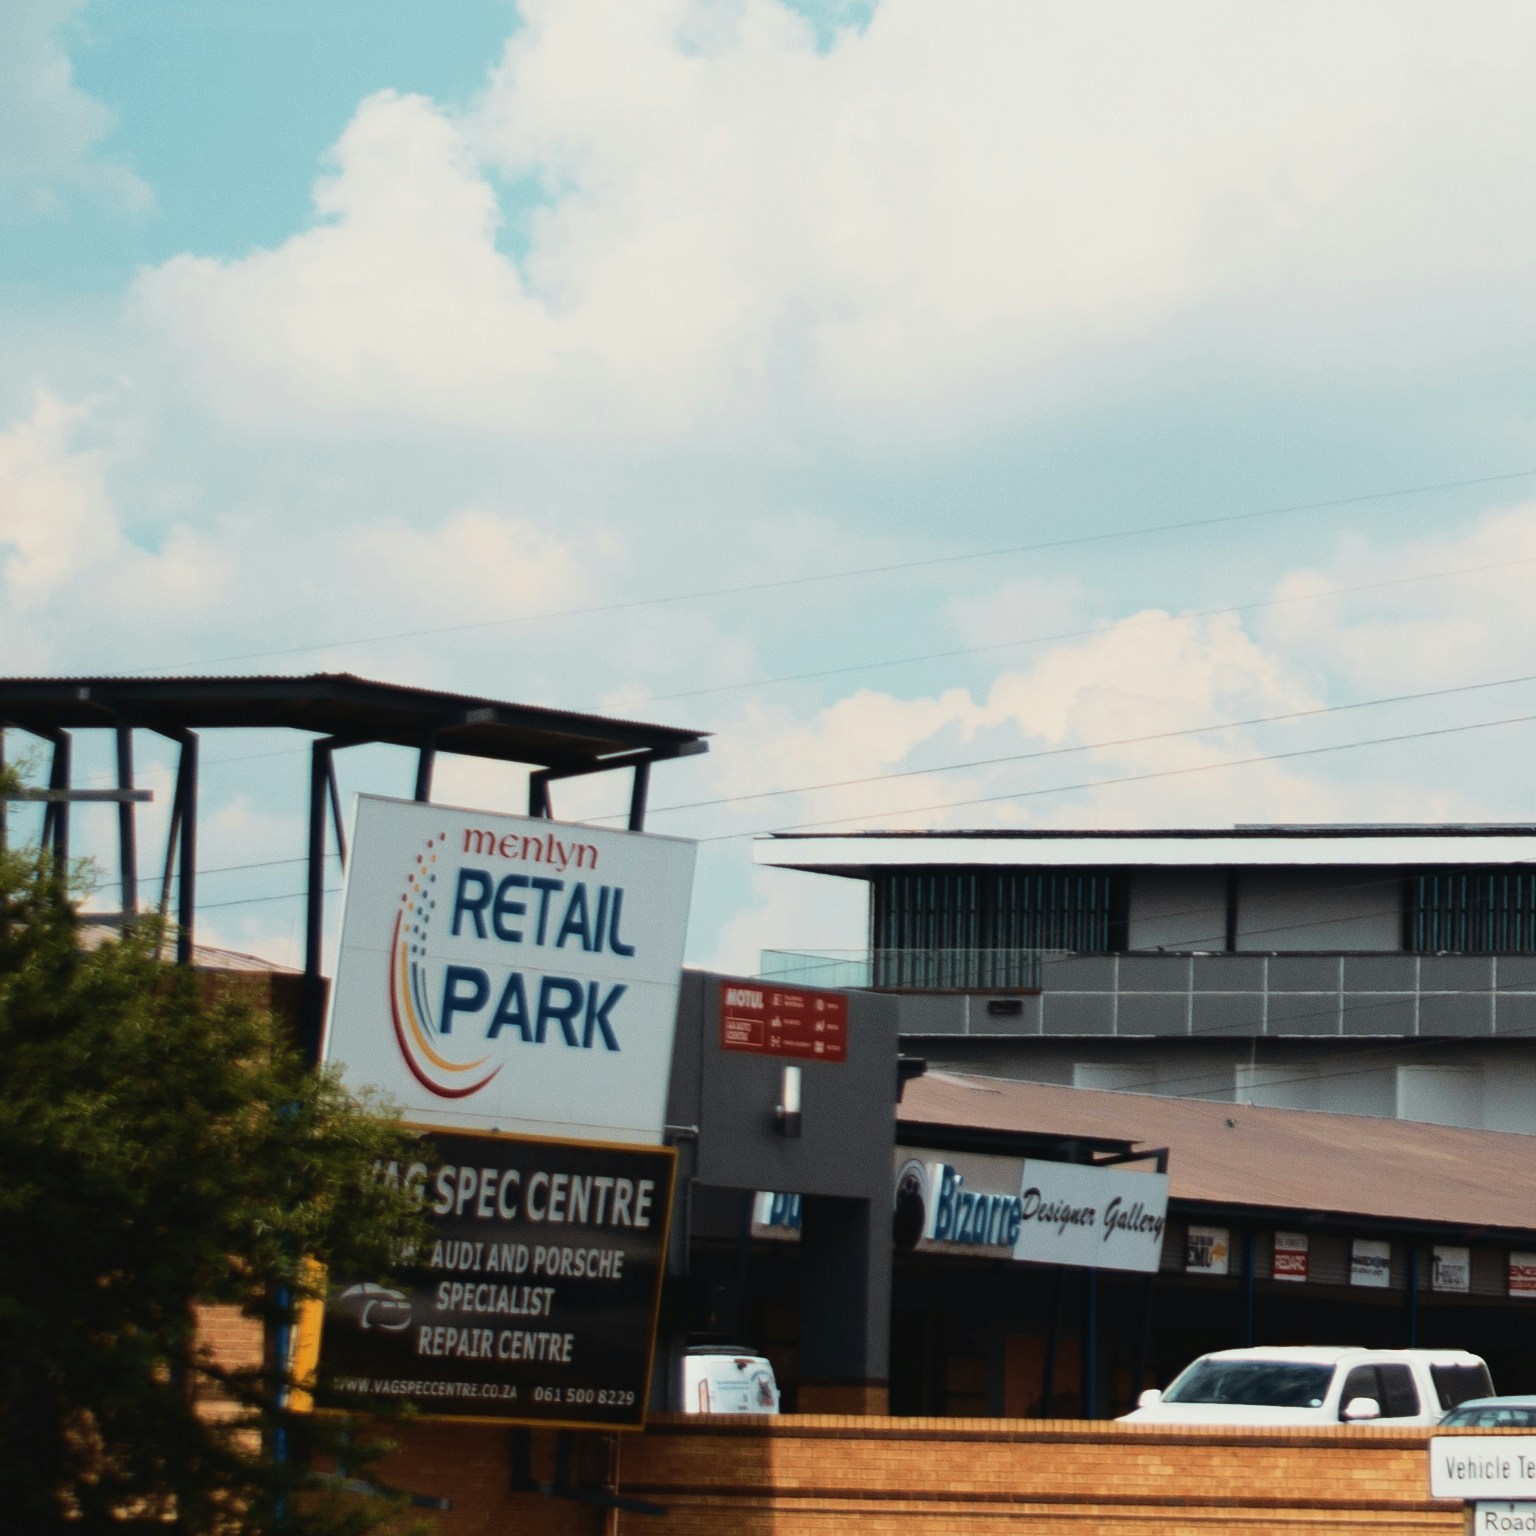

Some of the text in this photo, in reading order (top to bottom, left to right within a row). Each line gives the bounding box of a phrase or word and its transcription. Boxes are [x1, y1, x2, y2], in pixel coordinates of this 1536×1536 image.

[463, 828, 599, 872] menlyn
[450, 866, 636, 958] RETAIL
[439, 964, 630, 1053] PARK
[432, 1164, 521, 1221] SPEC
[526, 1171, 656, 1228] CENTRE
[934, 1163, 1166, 1247] Bizarre Designer Gallery
[431, 1239, 485, 1271] AUDI
[486, 1242, 531, 1276] AND
[533, 1245, 625, 1280] PORSCHE
[436, 1281, 556, 1316] SPECIALIST
[418, 1325, 575, 1363] REPAIR CENTRE
[534, 1385, 562, 1403] 061
[565, 1386, 594, 1405] 500
[597, 1388, 636, 1407] 8229
[1445, 1455, 1511, 1480] Vehicle
